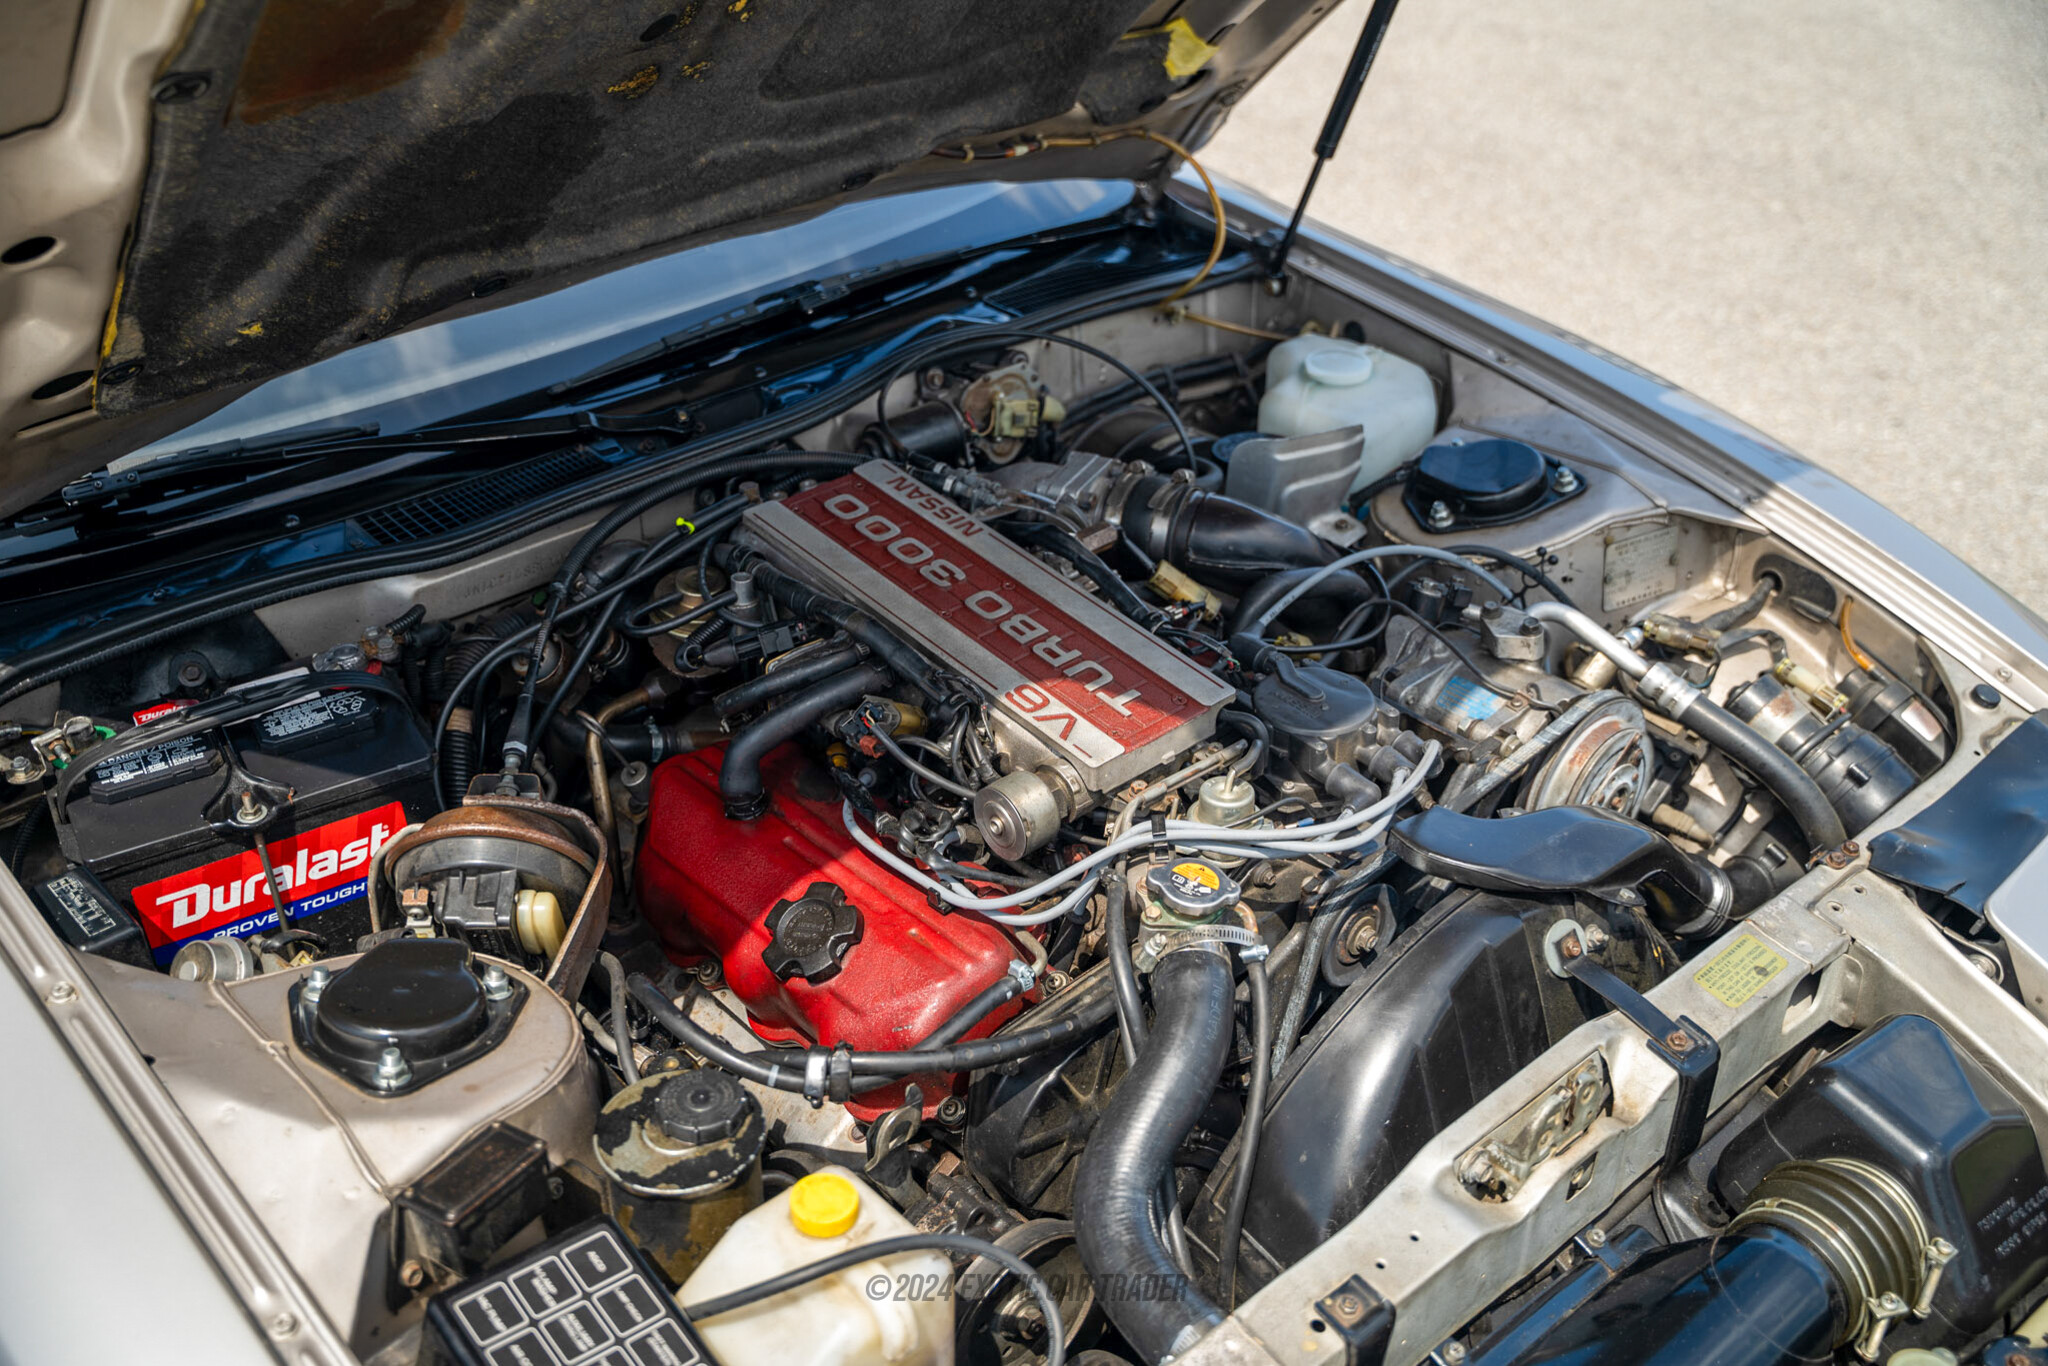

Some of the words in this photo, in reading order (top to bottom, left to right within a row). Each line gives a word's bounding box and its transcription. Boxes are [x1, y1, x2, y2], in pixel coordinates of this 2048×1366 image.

[886, 476, 984, 537] NISSAN
[824, 492, 967, 588] 3000
[964, 589, 1143, 718] TURBO
[1004, 683, 1077, 742] V6
[160, 735, 194, 752] POISON
[156, 823, 390, 928] Duralast
[213, 906, 295, 938] PROVEN
[300, 884, 366, 912] TOUGH
